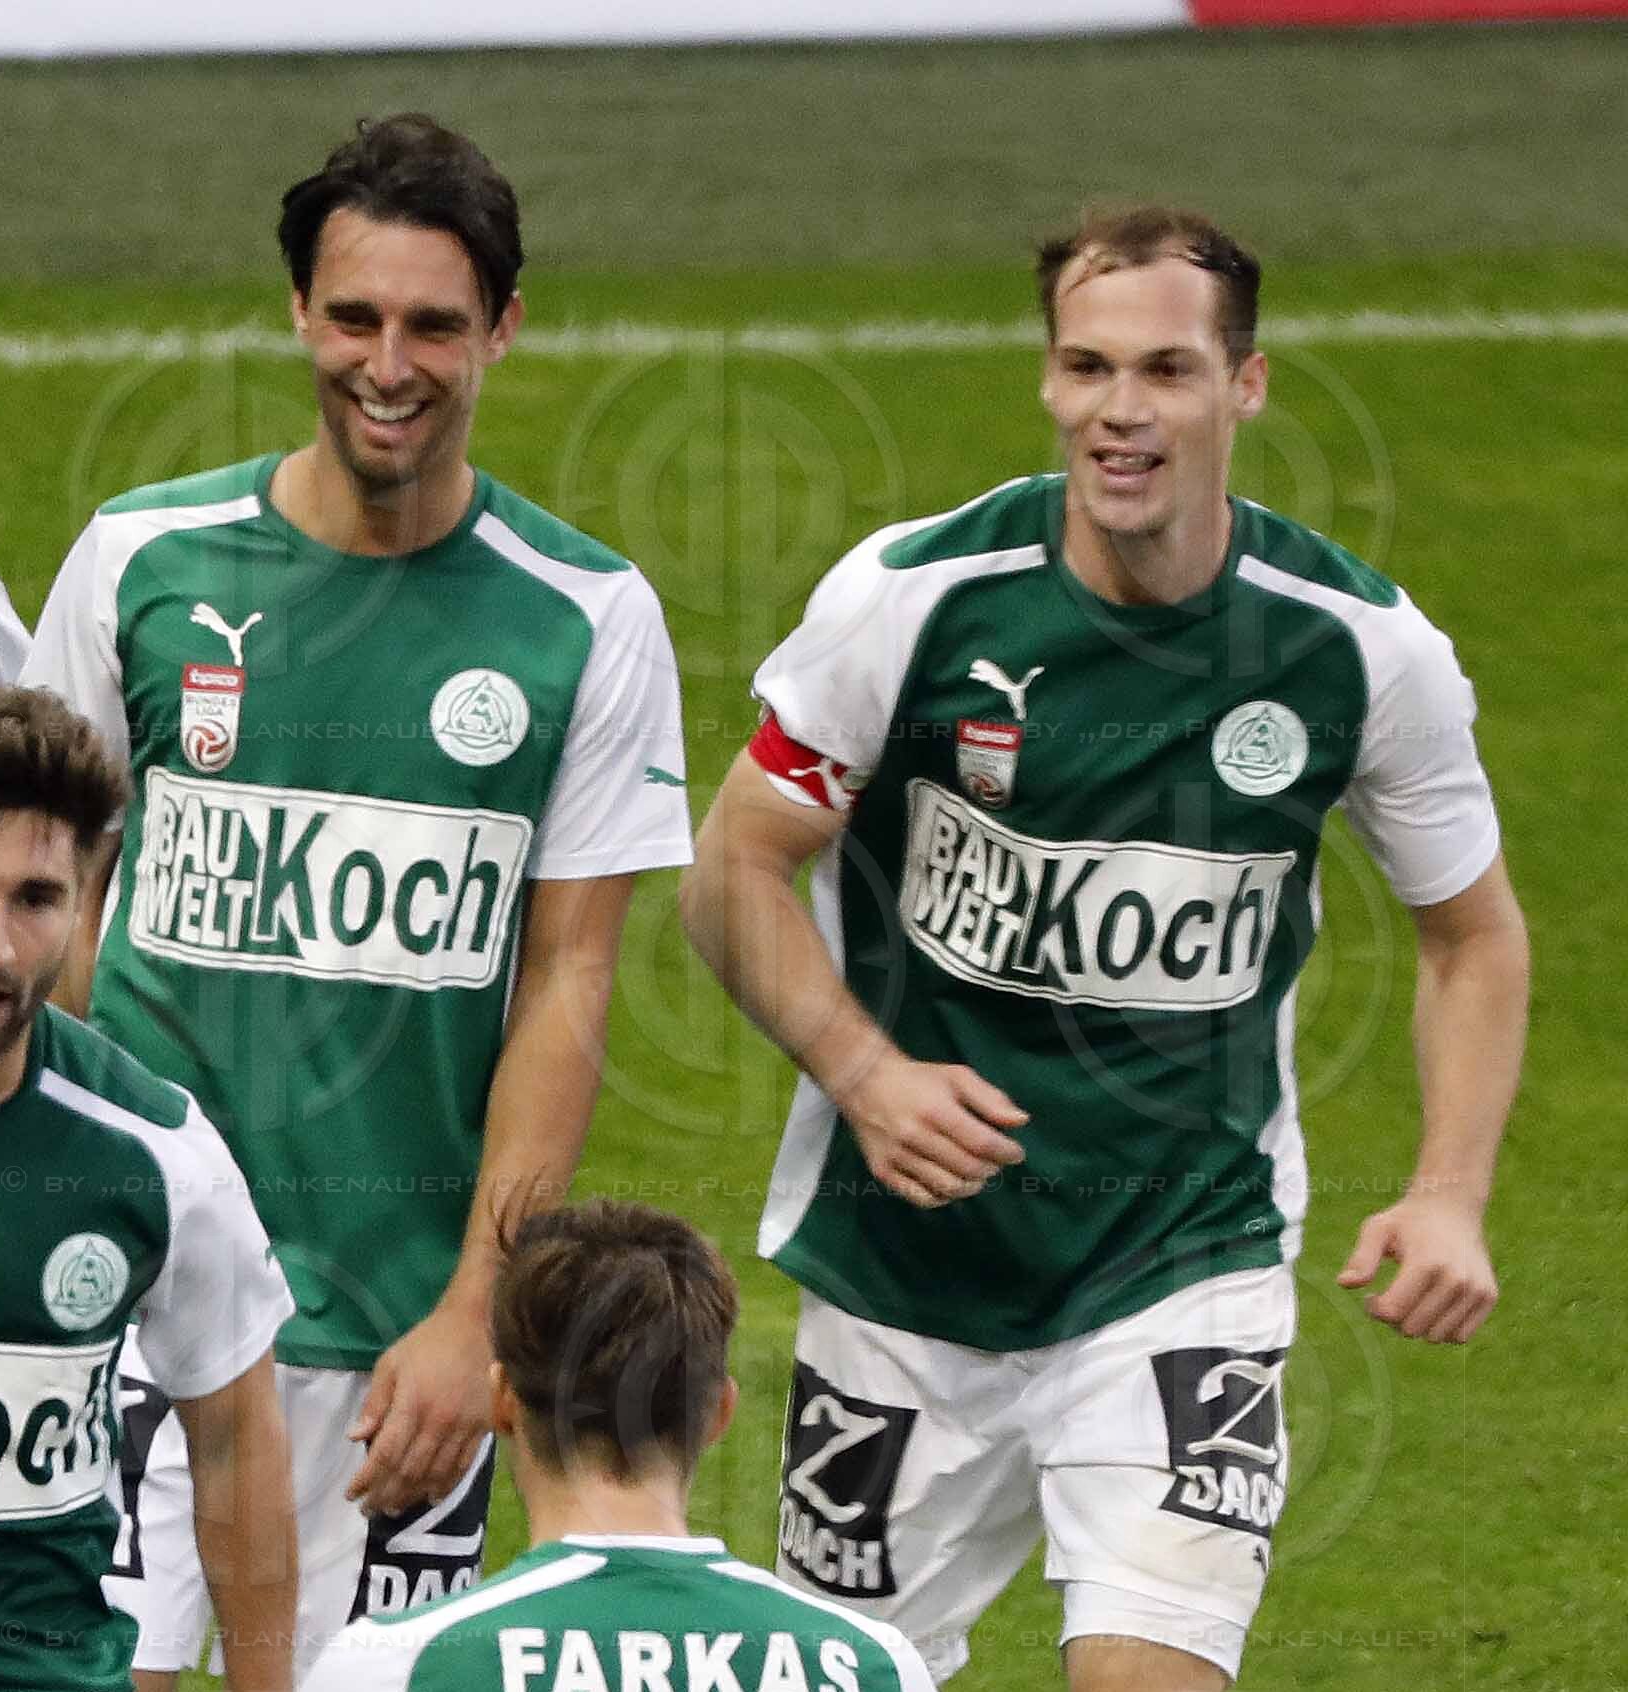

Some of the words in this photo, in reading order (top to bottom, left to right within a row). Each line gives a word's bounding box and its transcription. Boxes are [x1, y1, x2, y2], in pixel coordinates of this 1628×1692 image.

[144, 866, 255, 949] WELT
[257, 805, 501, 956] Koch
[156, 793, 246, 878] BAU
[928, 804, 1020, 906] BAU
[915, 869, 1023, 974] WELT
[1022, 857, 1266, 981] Koch
